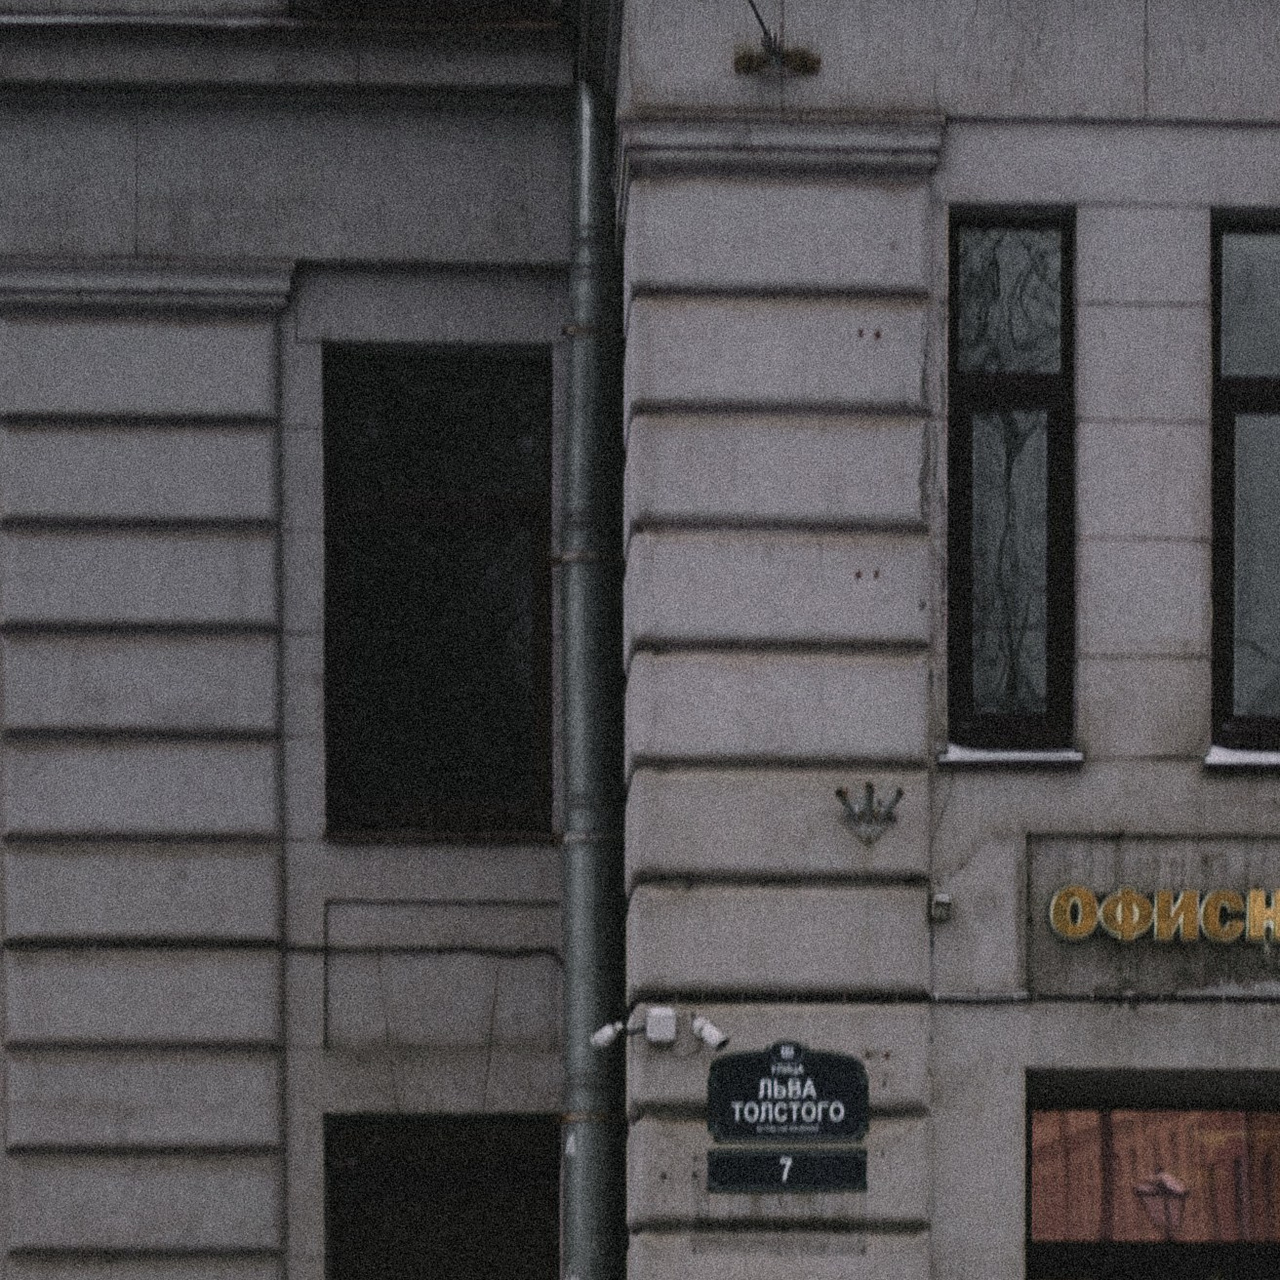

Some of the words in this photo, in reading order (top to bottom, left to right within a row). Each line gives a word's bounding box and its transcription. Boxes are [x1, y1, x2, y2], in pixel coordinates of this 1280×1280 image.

[758, 1077, 817, 1099] ЛЬВА
[731, 1100, 846, 1123] ТОЛСТОГО
[779, 1156, 793, 1182] 7
